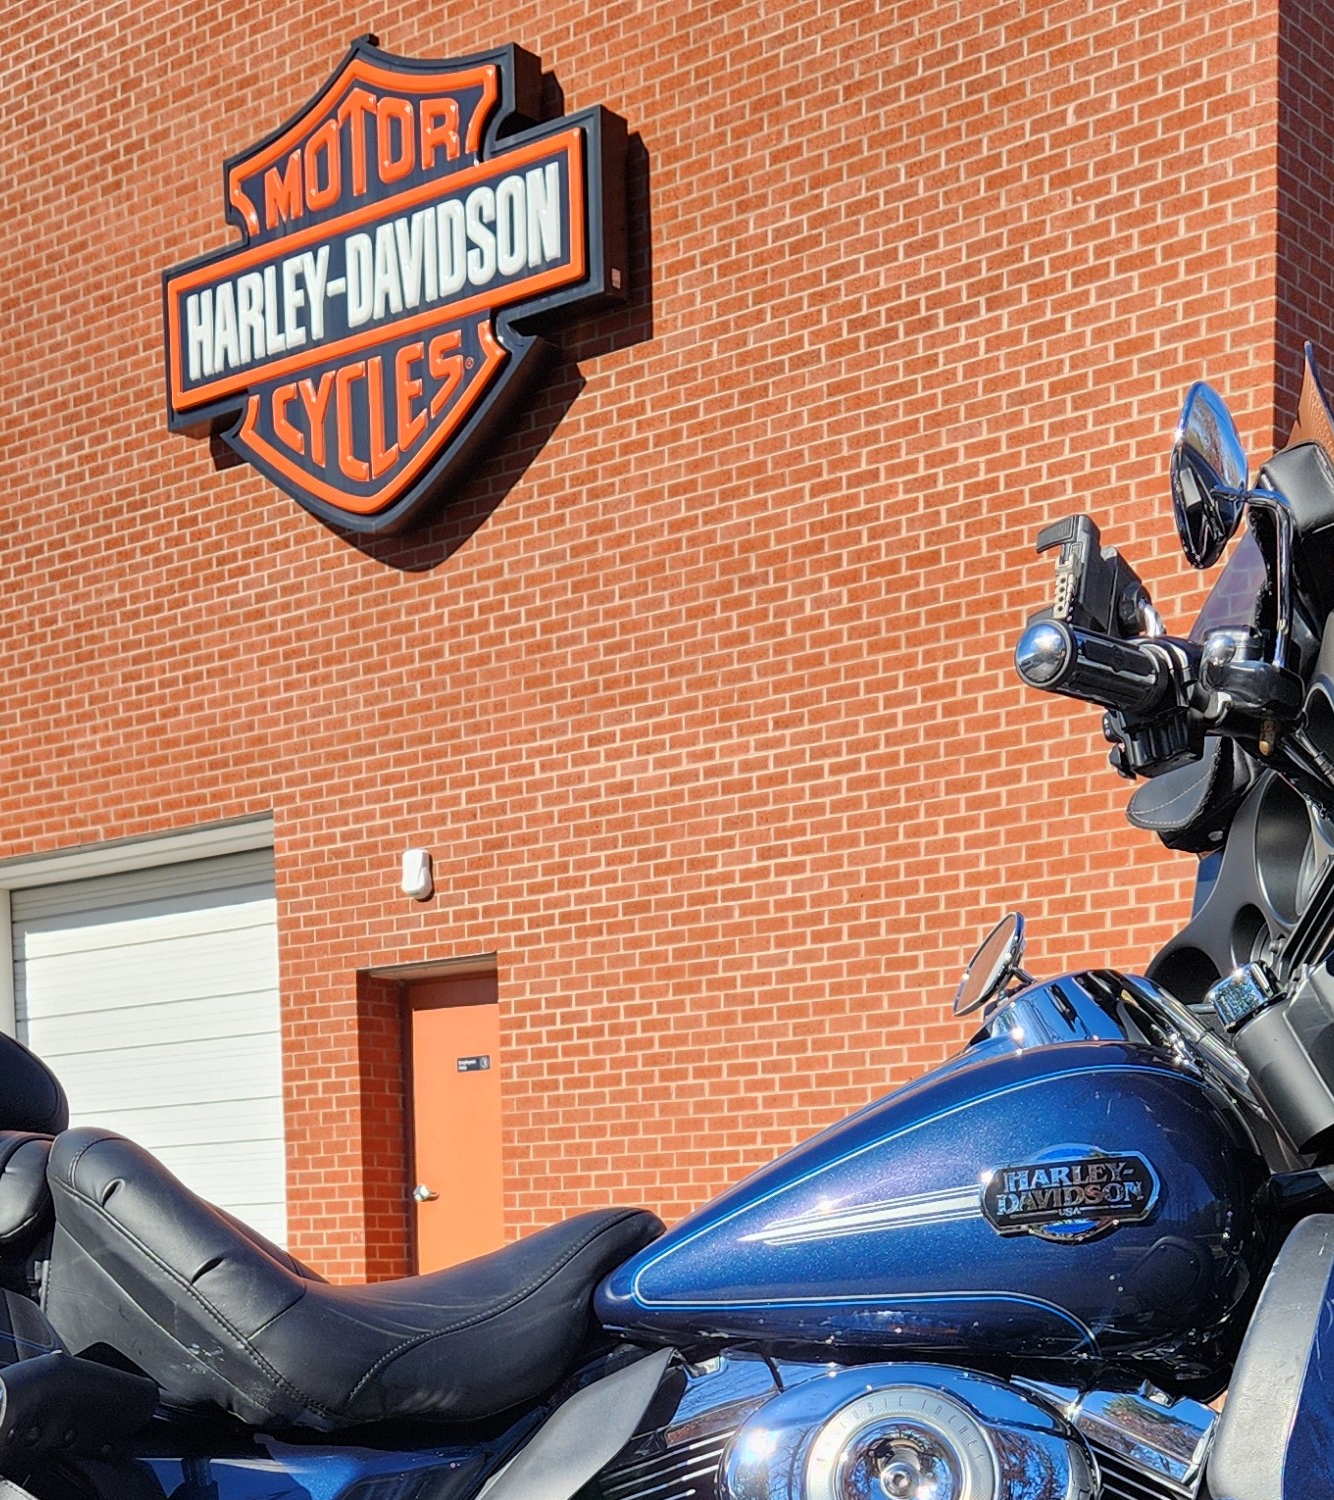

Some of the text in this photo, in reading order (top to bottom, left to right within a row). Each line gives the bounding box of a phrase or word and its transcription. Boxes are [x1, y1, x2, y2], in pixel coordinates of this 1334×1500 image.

[263, 93, 463, 231] MOTOR
[185, 161, 562, 382] HARLEY-DAVIDSON
[271, 329, 464, 482] CYCLES
[996, 1181, 1145, 1216] DAVIDSON
[1003, 1161, 1135, 1194] HARLEY-
[1058, 1207, 1082, 1217] USA
